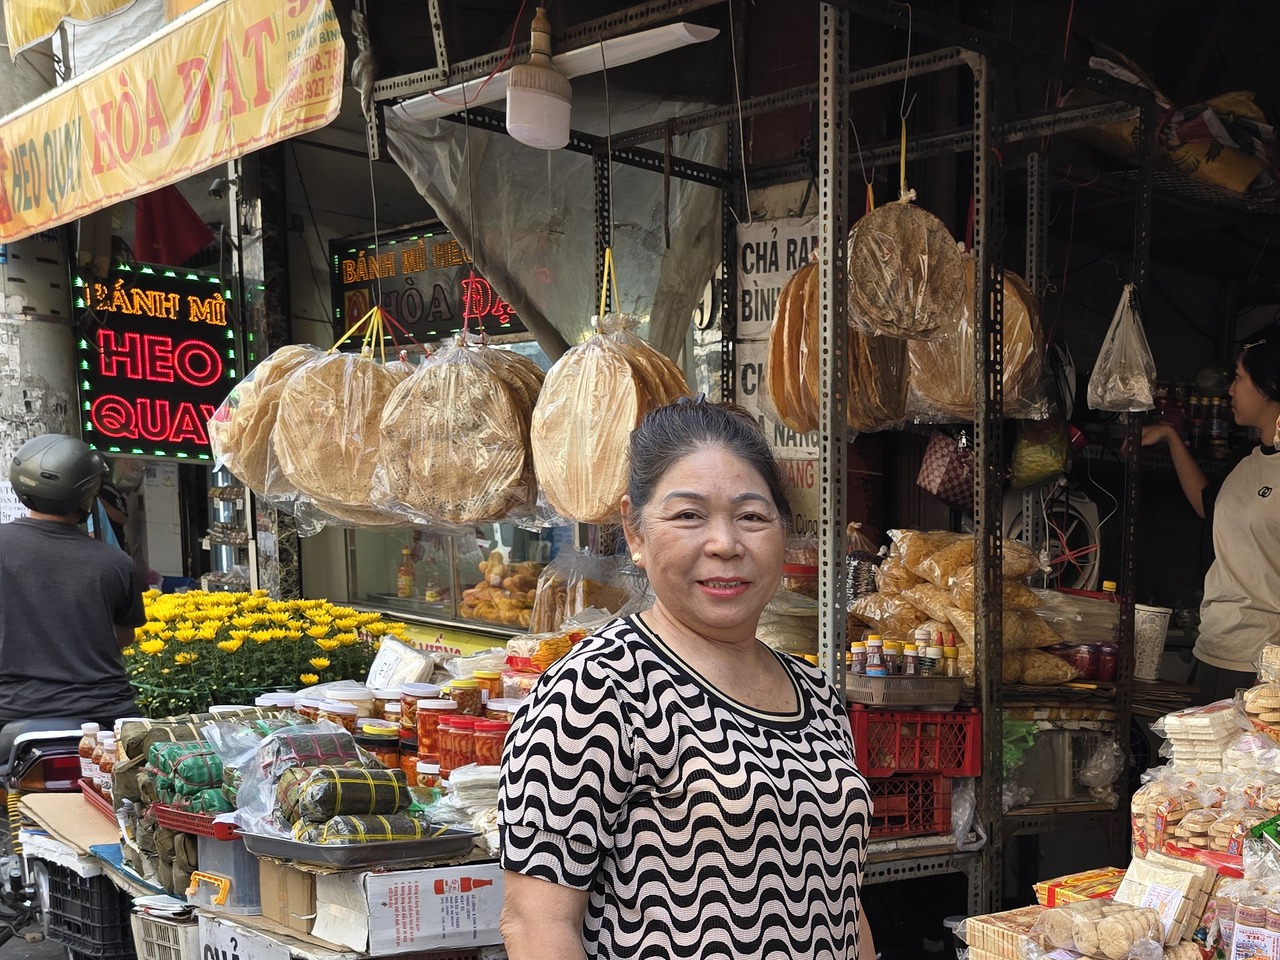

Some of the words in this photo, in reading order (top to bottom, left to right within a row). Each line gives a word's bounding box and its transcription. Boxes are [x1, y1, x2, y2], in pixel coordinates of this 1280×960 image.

[11, 138, 38, 213] HEO
[43, 116, 82, 213] QUAY
[90, 71, 173, 177] HÒA
[342, 251, 396, 284] BÁNH
[741, 228, 779, 275] CHẢ
[84, 279, 180, 320] BÁNH
[381, 277, 454, 325] HÒA
[97, 328, 223, 387] HEO
